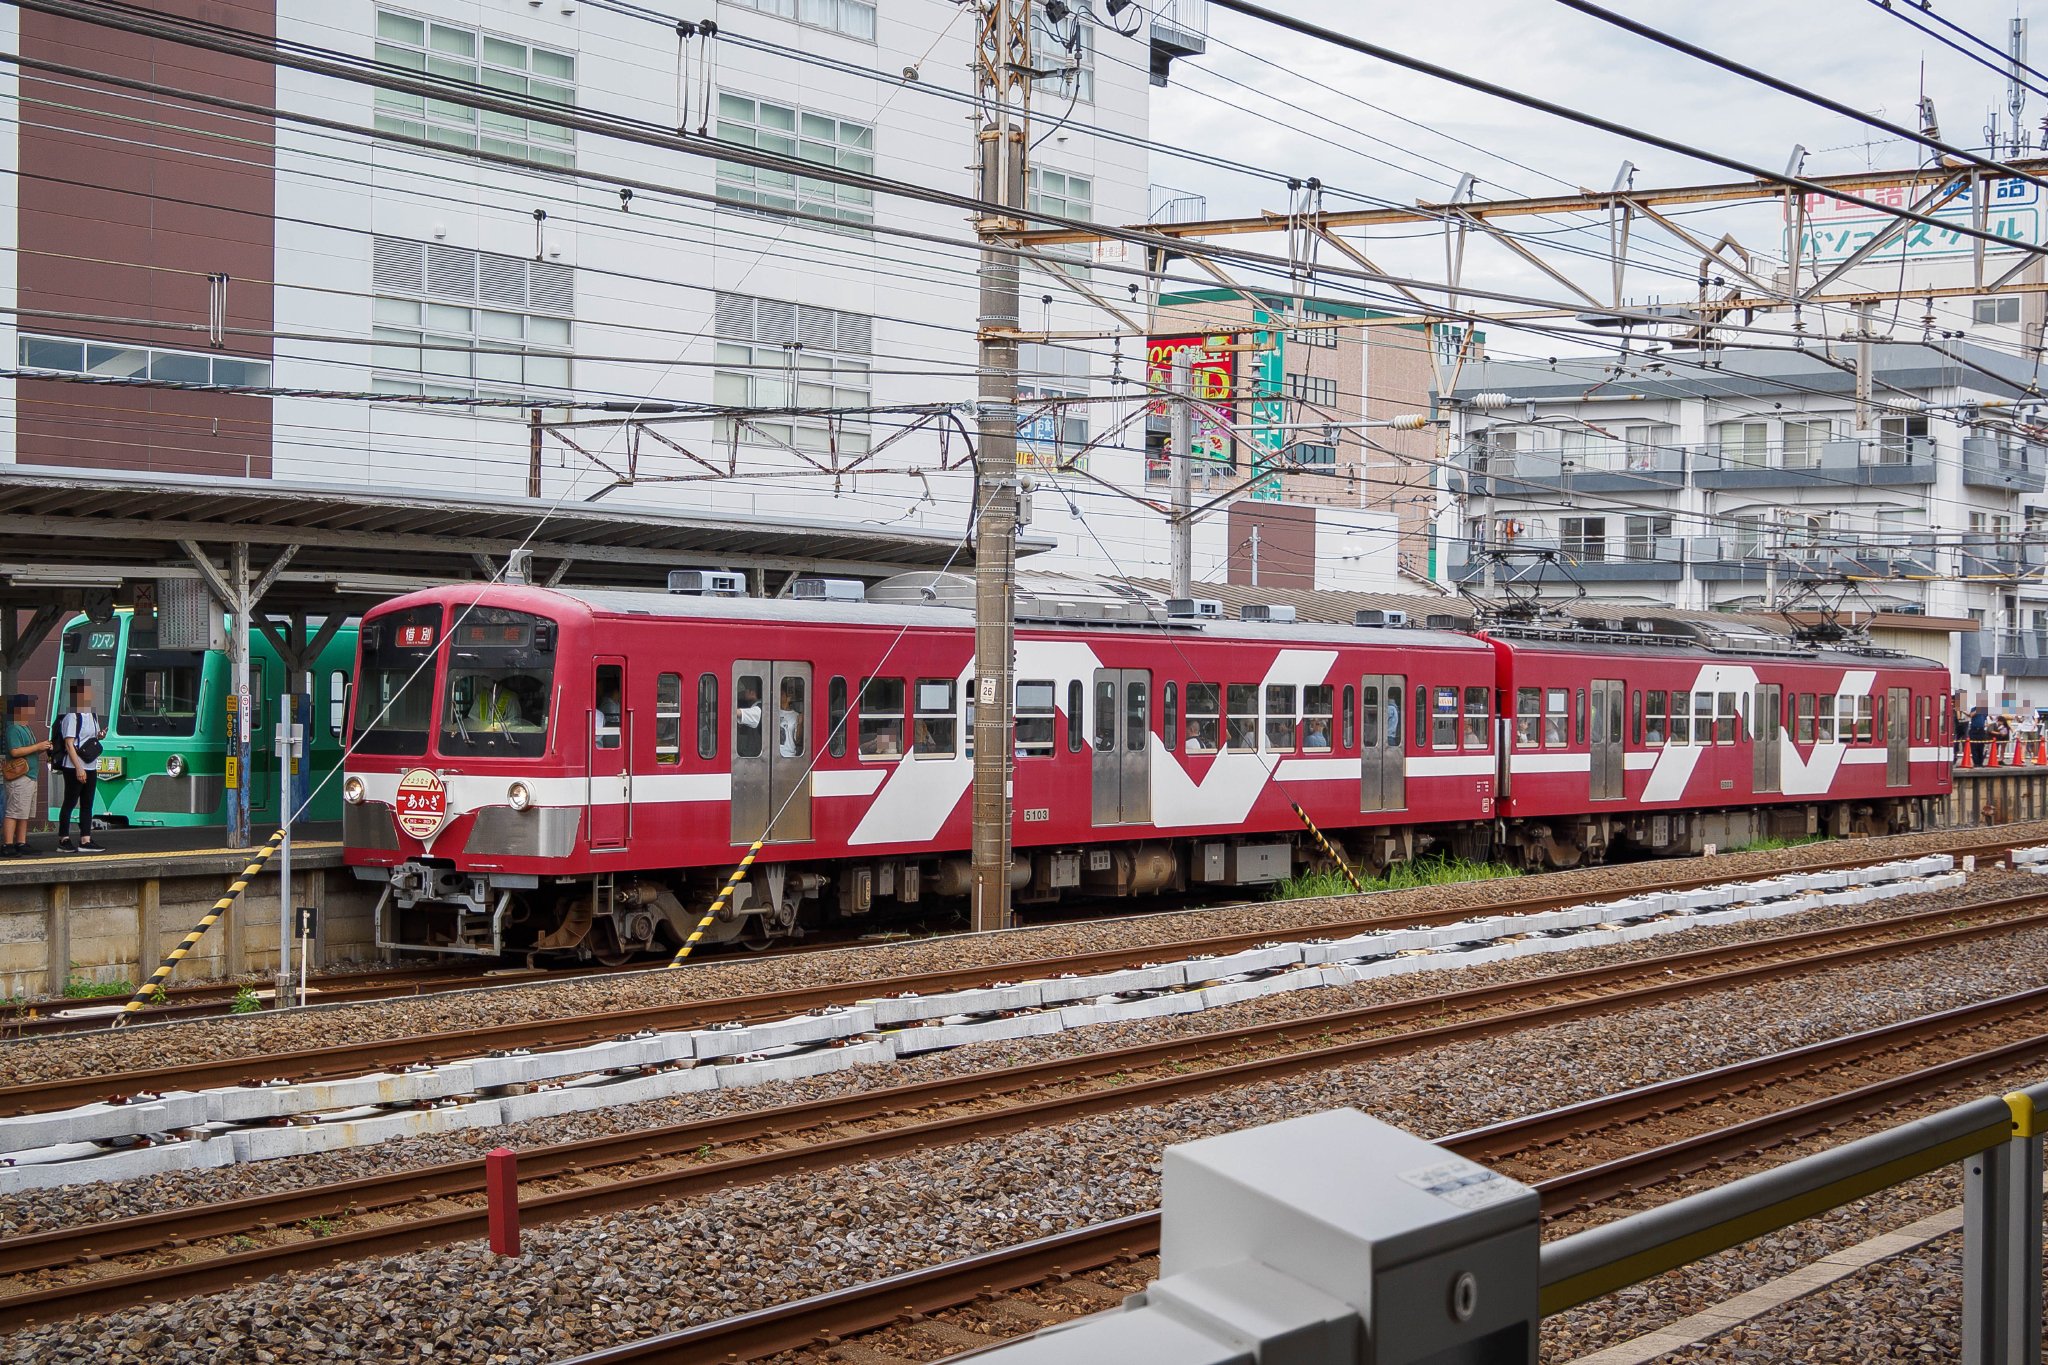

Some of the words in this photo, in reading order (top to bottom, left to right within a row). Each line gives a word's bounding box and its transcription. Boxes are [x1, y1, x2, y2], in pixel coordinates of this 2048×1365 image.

[91, 633, 116, 649] ワンマン
[983, 686, 993, 697] 26
[428, 778, 440, 791] N
[407, 793, 440, 811] あかぎ
[1025, 809, 1048, 821] 5103
